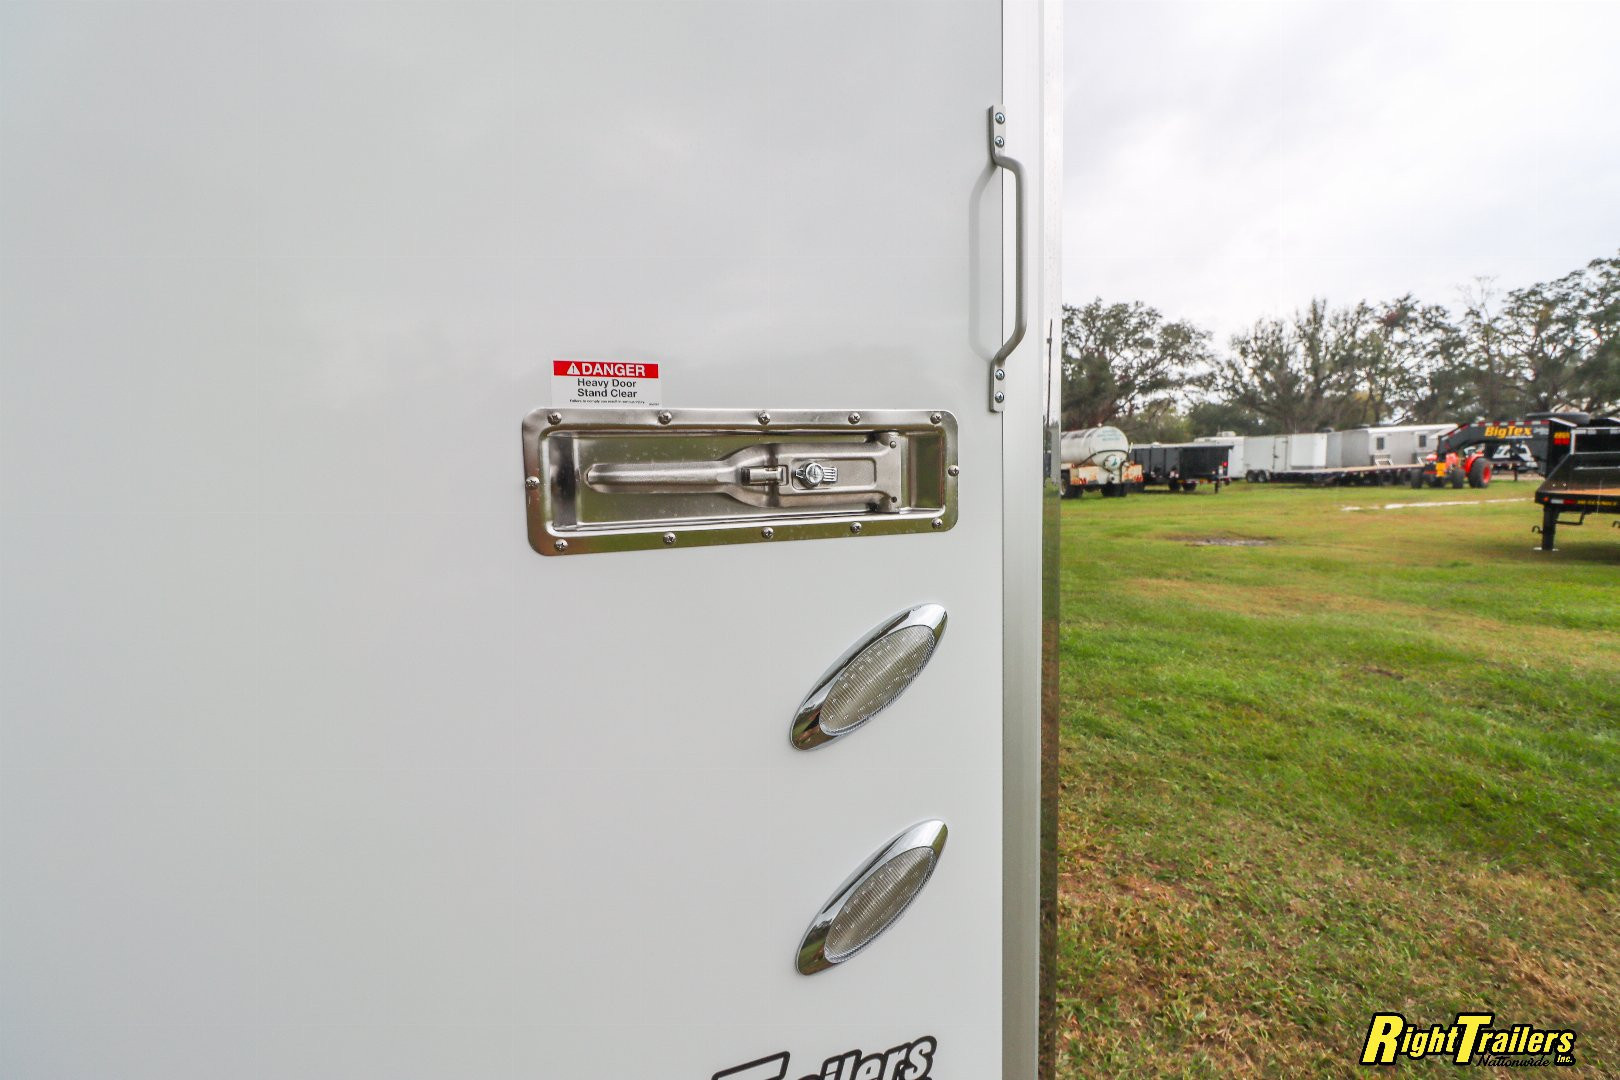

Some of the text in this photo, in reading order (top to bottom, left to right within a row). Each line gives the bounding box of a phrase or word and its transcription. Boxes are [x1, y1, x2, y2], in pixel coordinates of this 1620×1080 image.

[582, 363, 646, 377] DANGER
[577, 378, 637, 388] Heavy Door
[577, 388, 638, 398] Stand Clear
